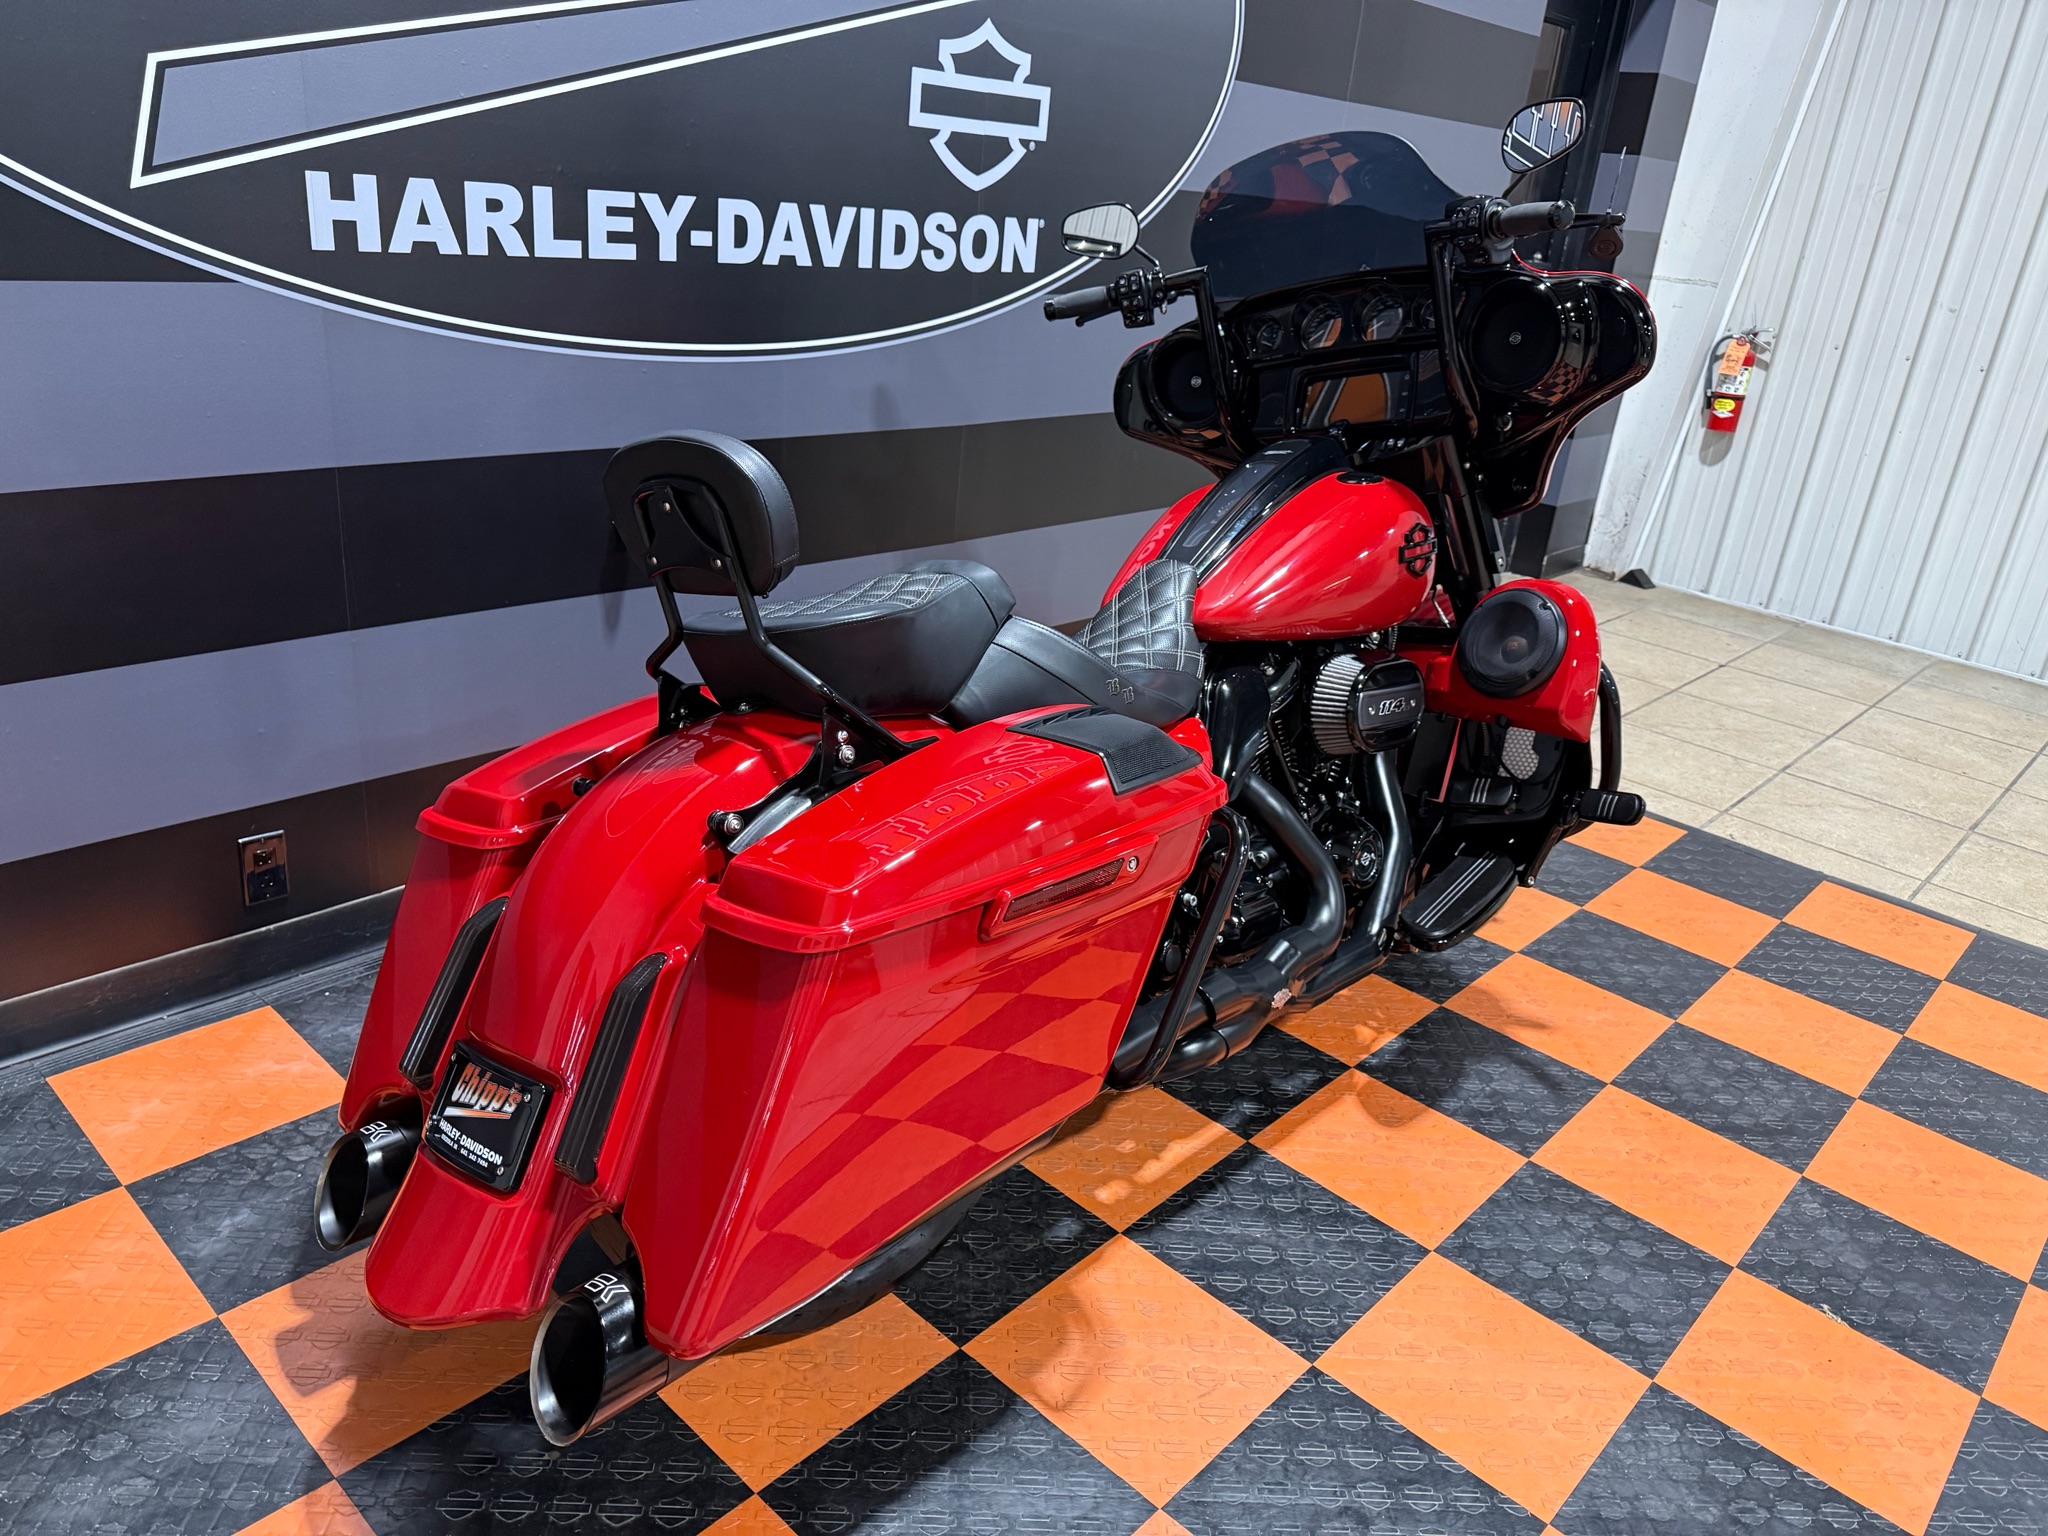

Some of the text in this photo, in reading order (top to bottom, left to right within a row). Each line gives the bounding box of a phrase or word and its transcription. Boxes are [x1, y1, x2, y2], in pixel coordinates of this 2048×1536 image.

[305, 170, 1039, 273] HARLEY-DAVIDSON
[1378, 697, 1405, 715] 114
[451, 1062, 522, 1113] Chipp's
[439, 1118, 503, 1165] HARLEY-DAVIDSON
